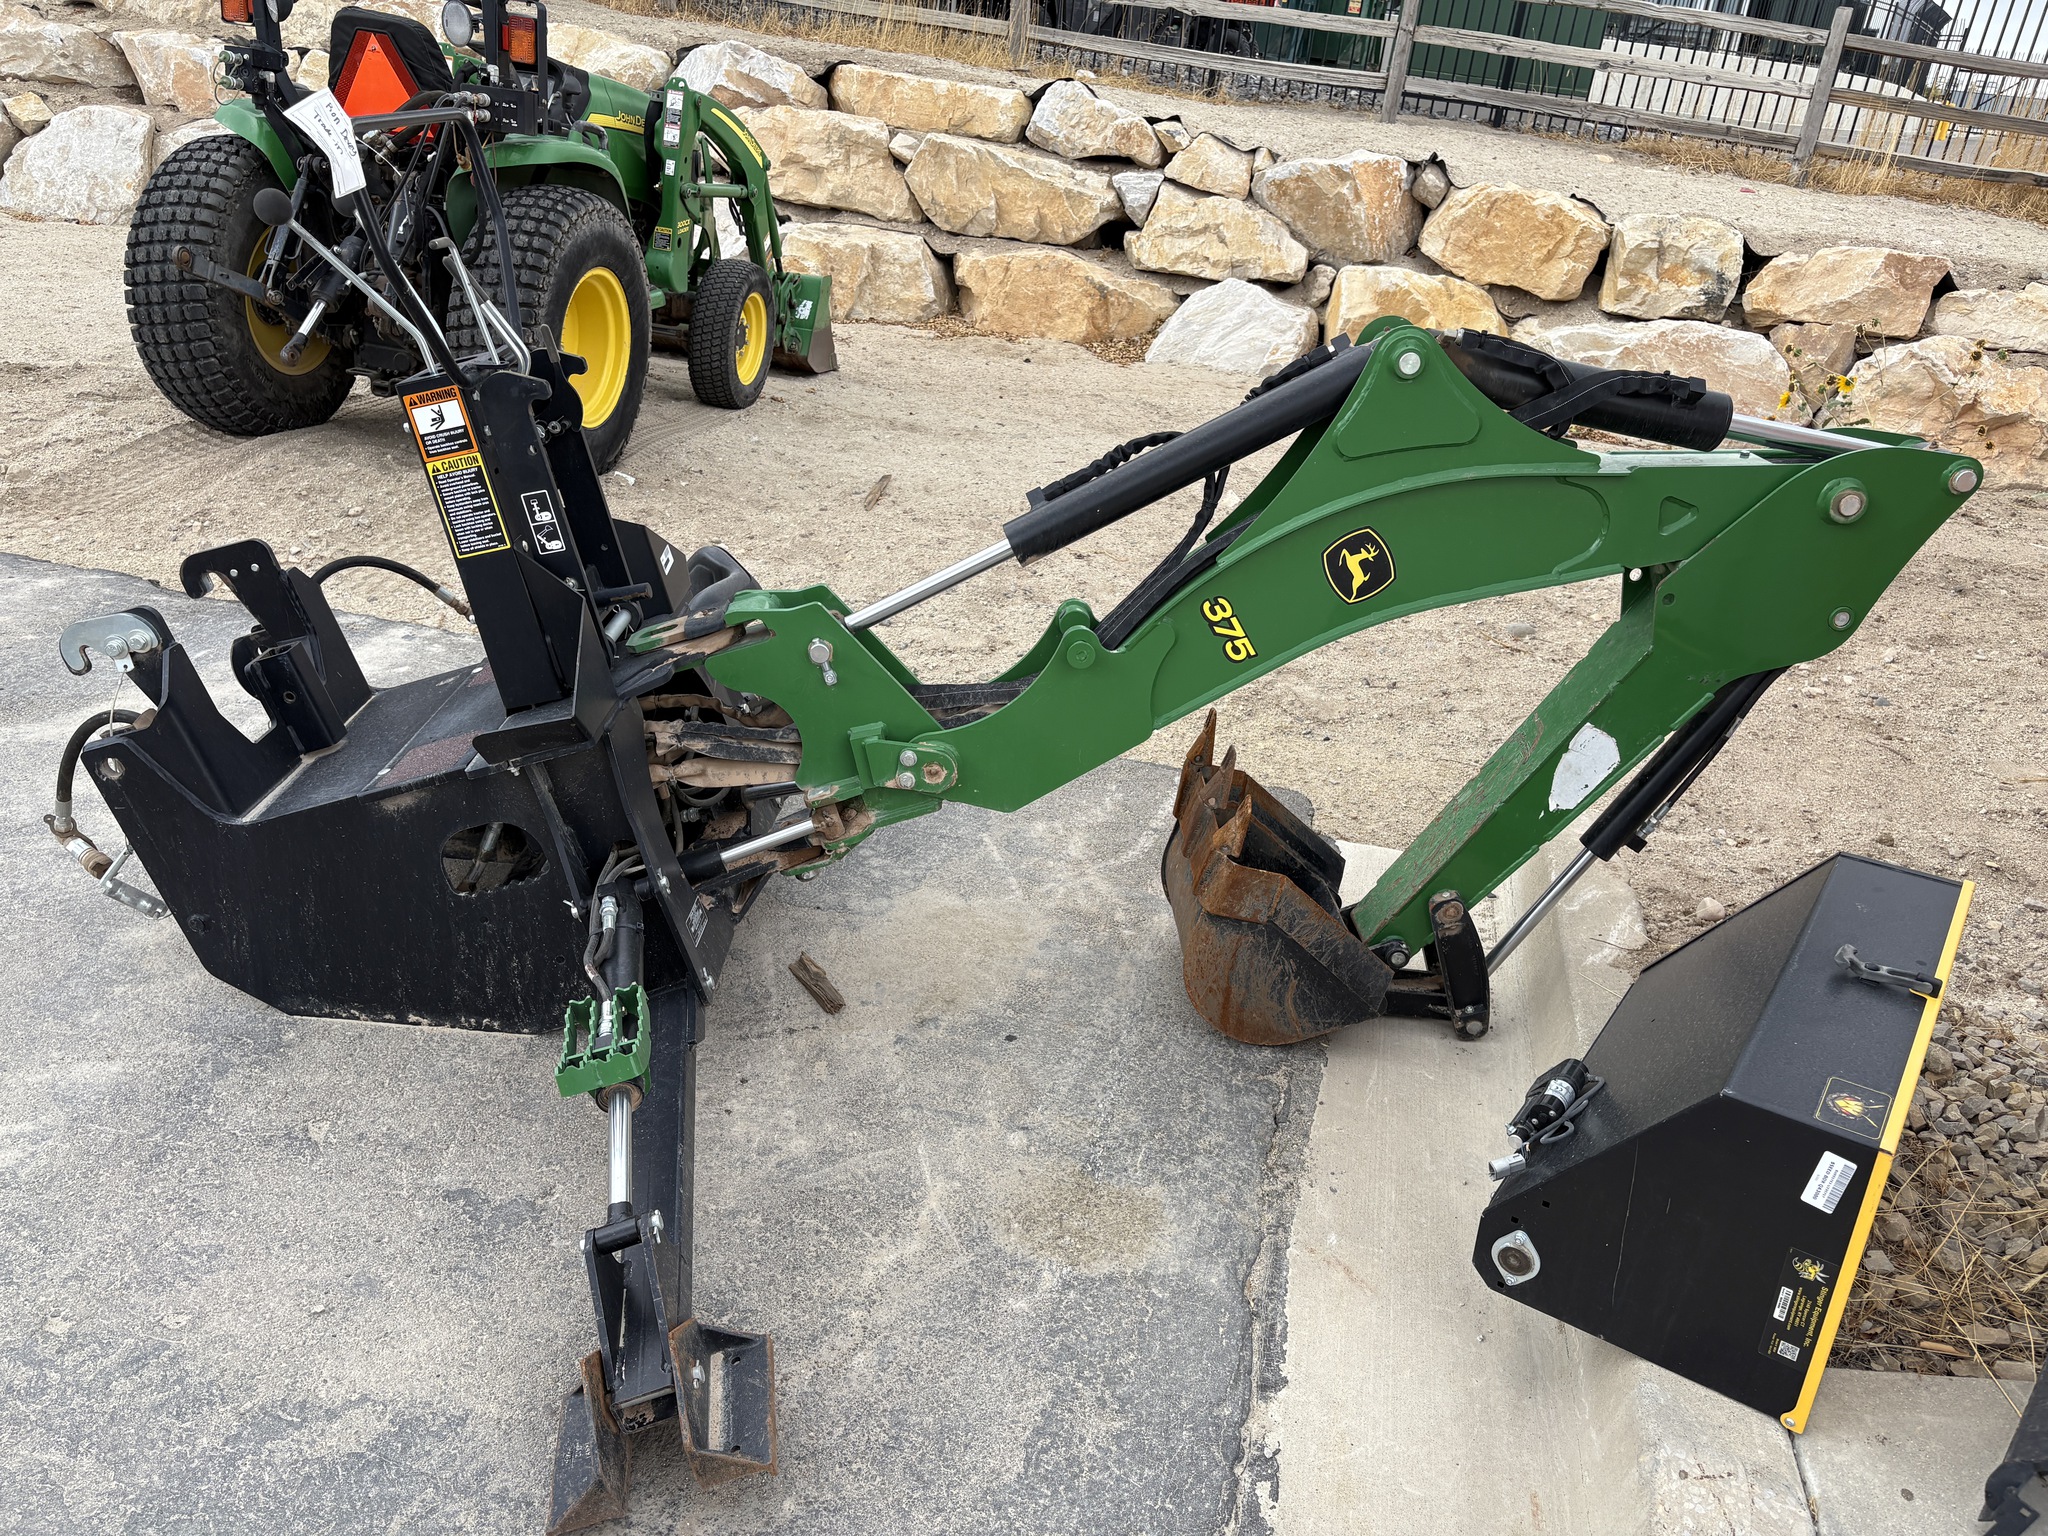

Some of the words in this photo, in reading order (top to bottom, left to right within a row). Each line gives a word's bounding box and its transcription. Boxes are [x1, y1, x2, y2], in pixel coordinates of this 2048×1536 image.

[615, 110, 635, 125] JOHN
[676, 218, 690, 228] 300CX
[416, 387, 457, 405] WARNING
[441, 454, 480, 471] CAUTION
[1198, 596, 1258, 663] 375
[1820, 1174, 1828, 1184] BOX
[1814, 1285, 1828, 1307] Stinger
[1804, 1306, 1822, 1338] Equipment,
[1802, 1337, 1812, 1348] Inc.
